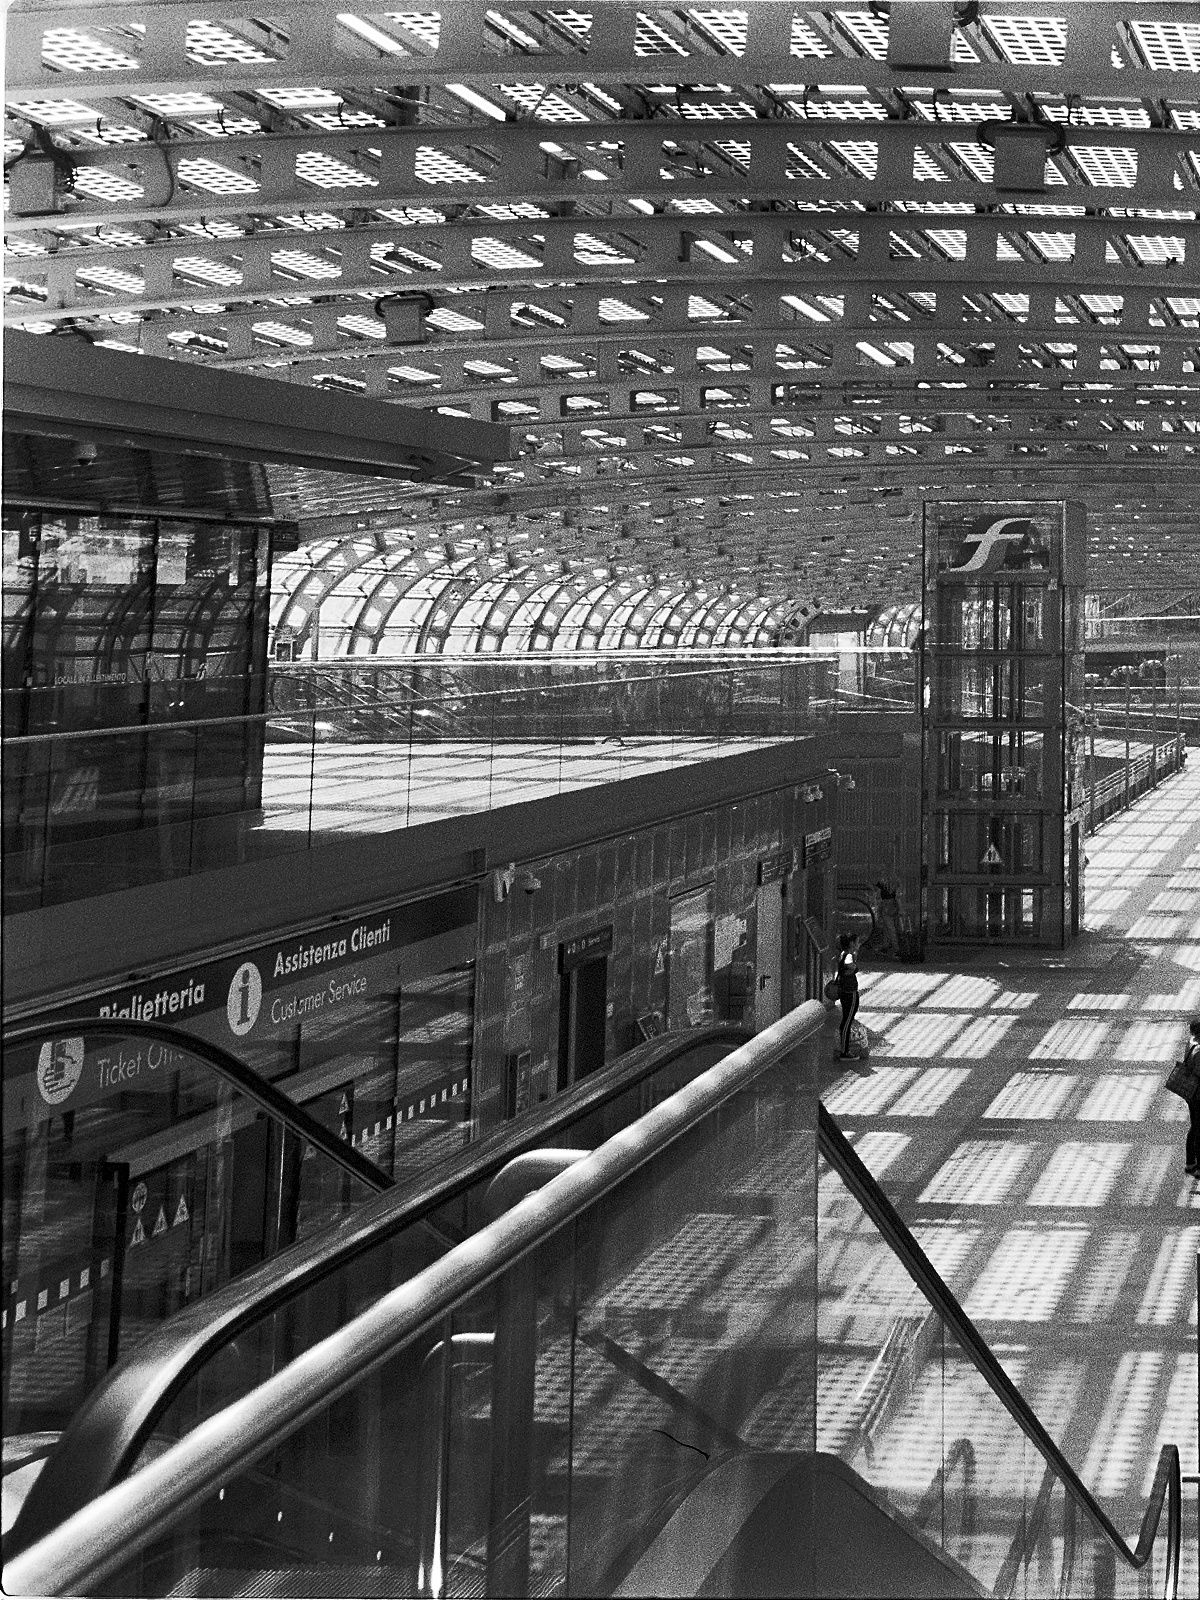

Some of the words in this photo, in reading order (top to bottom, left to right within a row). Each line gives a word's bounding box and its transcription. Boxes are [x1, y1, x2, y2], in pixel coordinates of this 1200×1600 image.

[273, 945, 347, 978] Assistenza
[351, 918, 391, 952] Clienti
[271, 990, 326, 1024] Customer
[328, 974, 367, 1004] Service
[97, 1051, 142, 1088] Ticket
